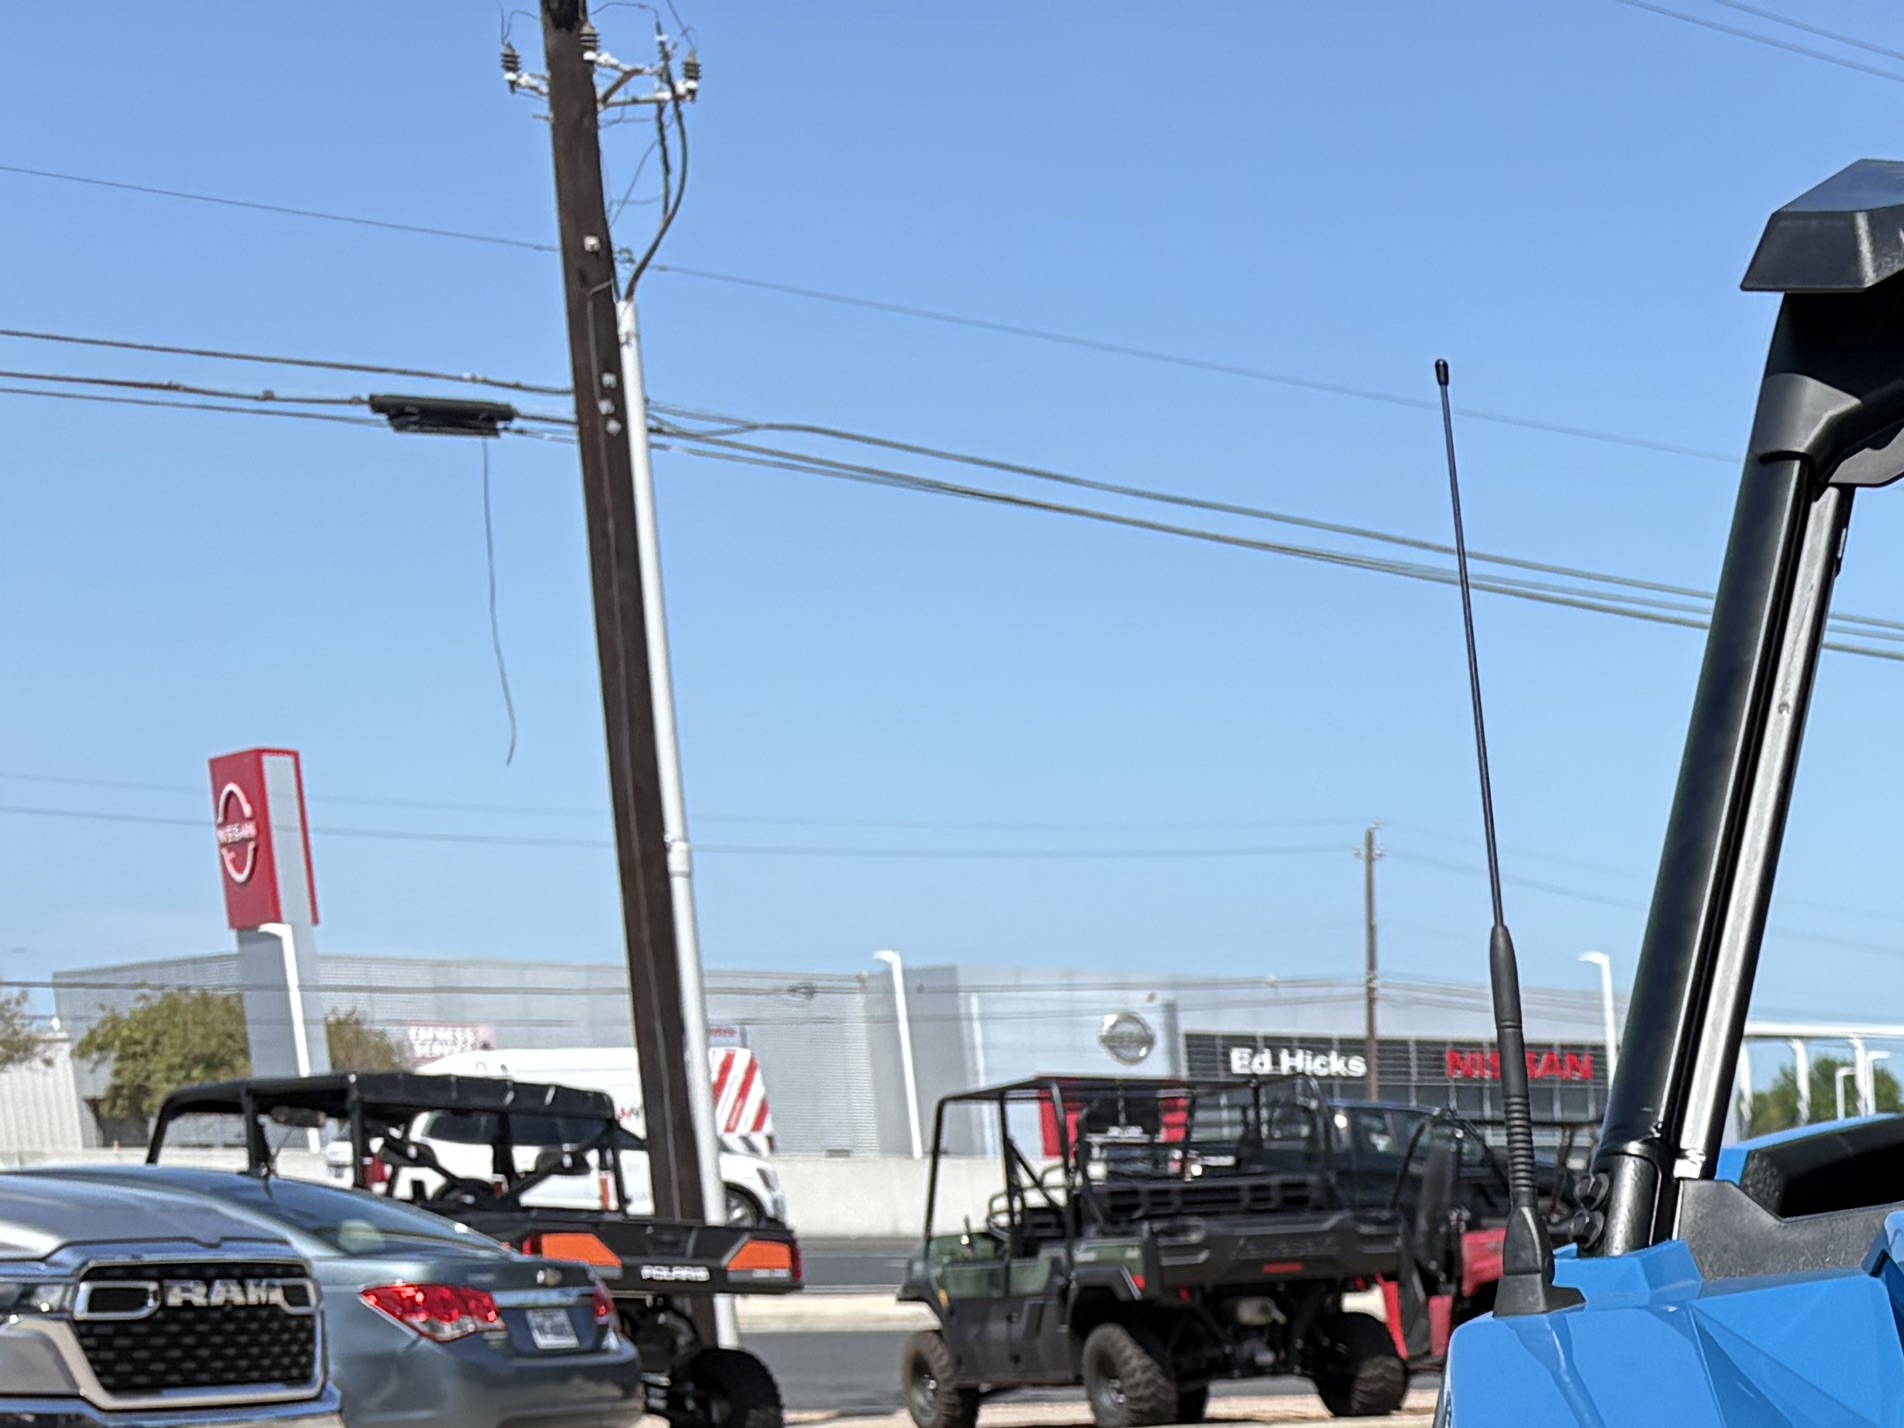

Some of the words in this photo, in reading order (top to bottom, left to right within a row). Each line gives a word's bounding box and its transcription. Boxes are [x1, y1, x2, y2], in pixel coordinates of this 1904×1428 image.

[1230, 1047, 1272, 1075] Ed
[1279, 1047, 1367, 1077] Hicks
[163, 1279, 284, 1307] RAM
